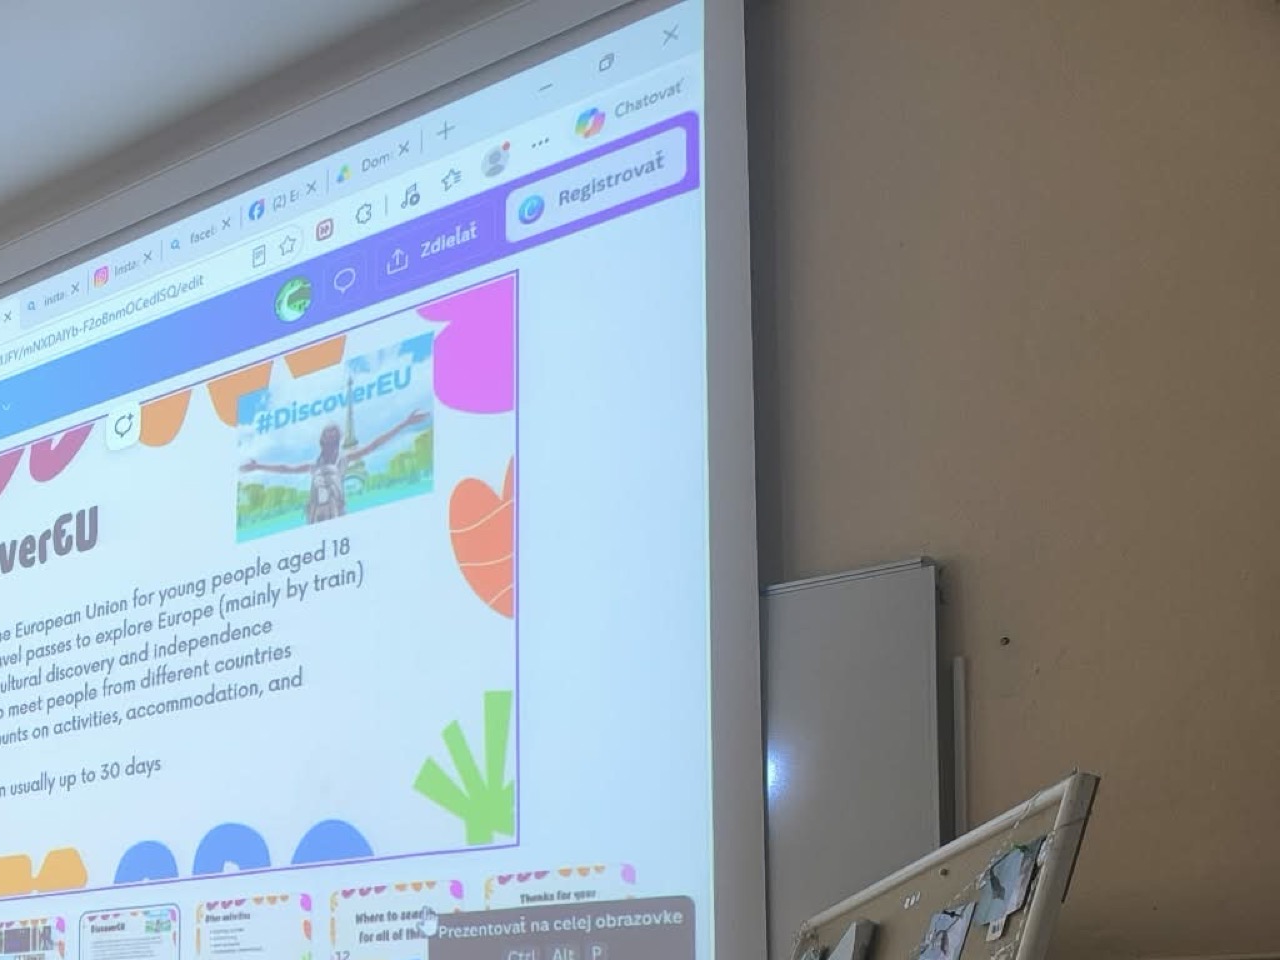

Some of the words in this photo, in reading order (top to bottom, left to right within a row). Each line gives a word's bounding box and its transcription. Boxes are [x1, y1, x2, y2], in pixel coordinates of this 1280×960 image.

[558, 150, 665, 207] Registrovať
[256, 366, 412, 434] #DiscoverEU
[16, 611, 81, 638] European
[87, 600, 128, 619] Union
[133, 587, 155, 608] for
[159, 579, 206, 606] young
[212, 556, 271, 593] people
[277, 540, 326, 573] aged
[333, 537, 351, 557] 18
[26, 641, 72, 666] passes
[76, 633, 91, 648] to
[96, 620, 153, 646] explore
[158, 604, 214, 630] Europe
[219, 582, 280, 620] (mainly
[287, 578, 308, 601] by
[314, 560, 364, 592] train)
[8, 700, 43, 717] meet
[47, 683, 97, 713] people
[102, 677, 136, 698] from
[141, 660, 210, 689] different
[214, 645, 292, 674] countries
[46, 657, 114, 684] discovery
[119, 643, 149, 666] and
[154, 619, 272, 660] independence
[32, 725, 50, 739] on
[54, 711, 122, 736] activities,
[125, 682, 264, 720] accommodation,
[269, 665, 304, 692] and
[10, 772, 55, 797] usually
[59, 773, 77, 792] up
[81, 768, 96, 784] to
[101, 762, 121, 780] 30
[125, 755, 161, 778] days
[438, 915, 527, 939] Prezentovať
[531, 919, 550, 932] na
[553, 914, 591, 933] celej
[596, 910, 682, 929] obrazovke
[592, 946, 602, 960] P
